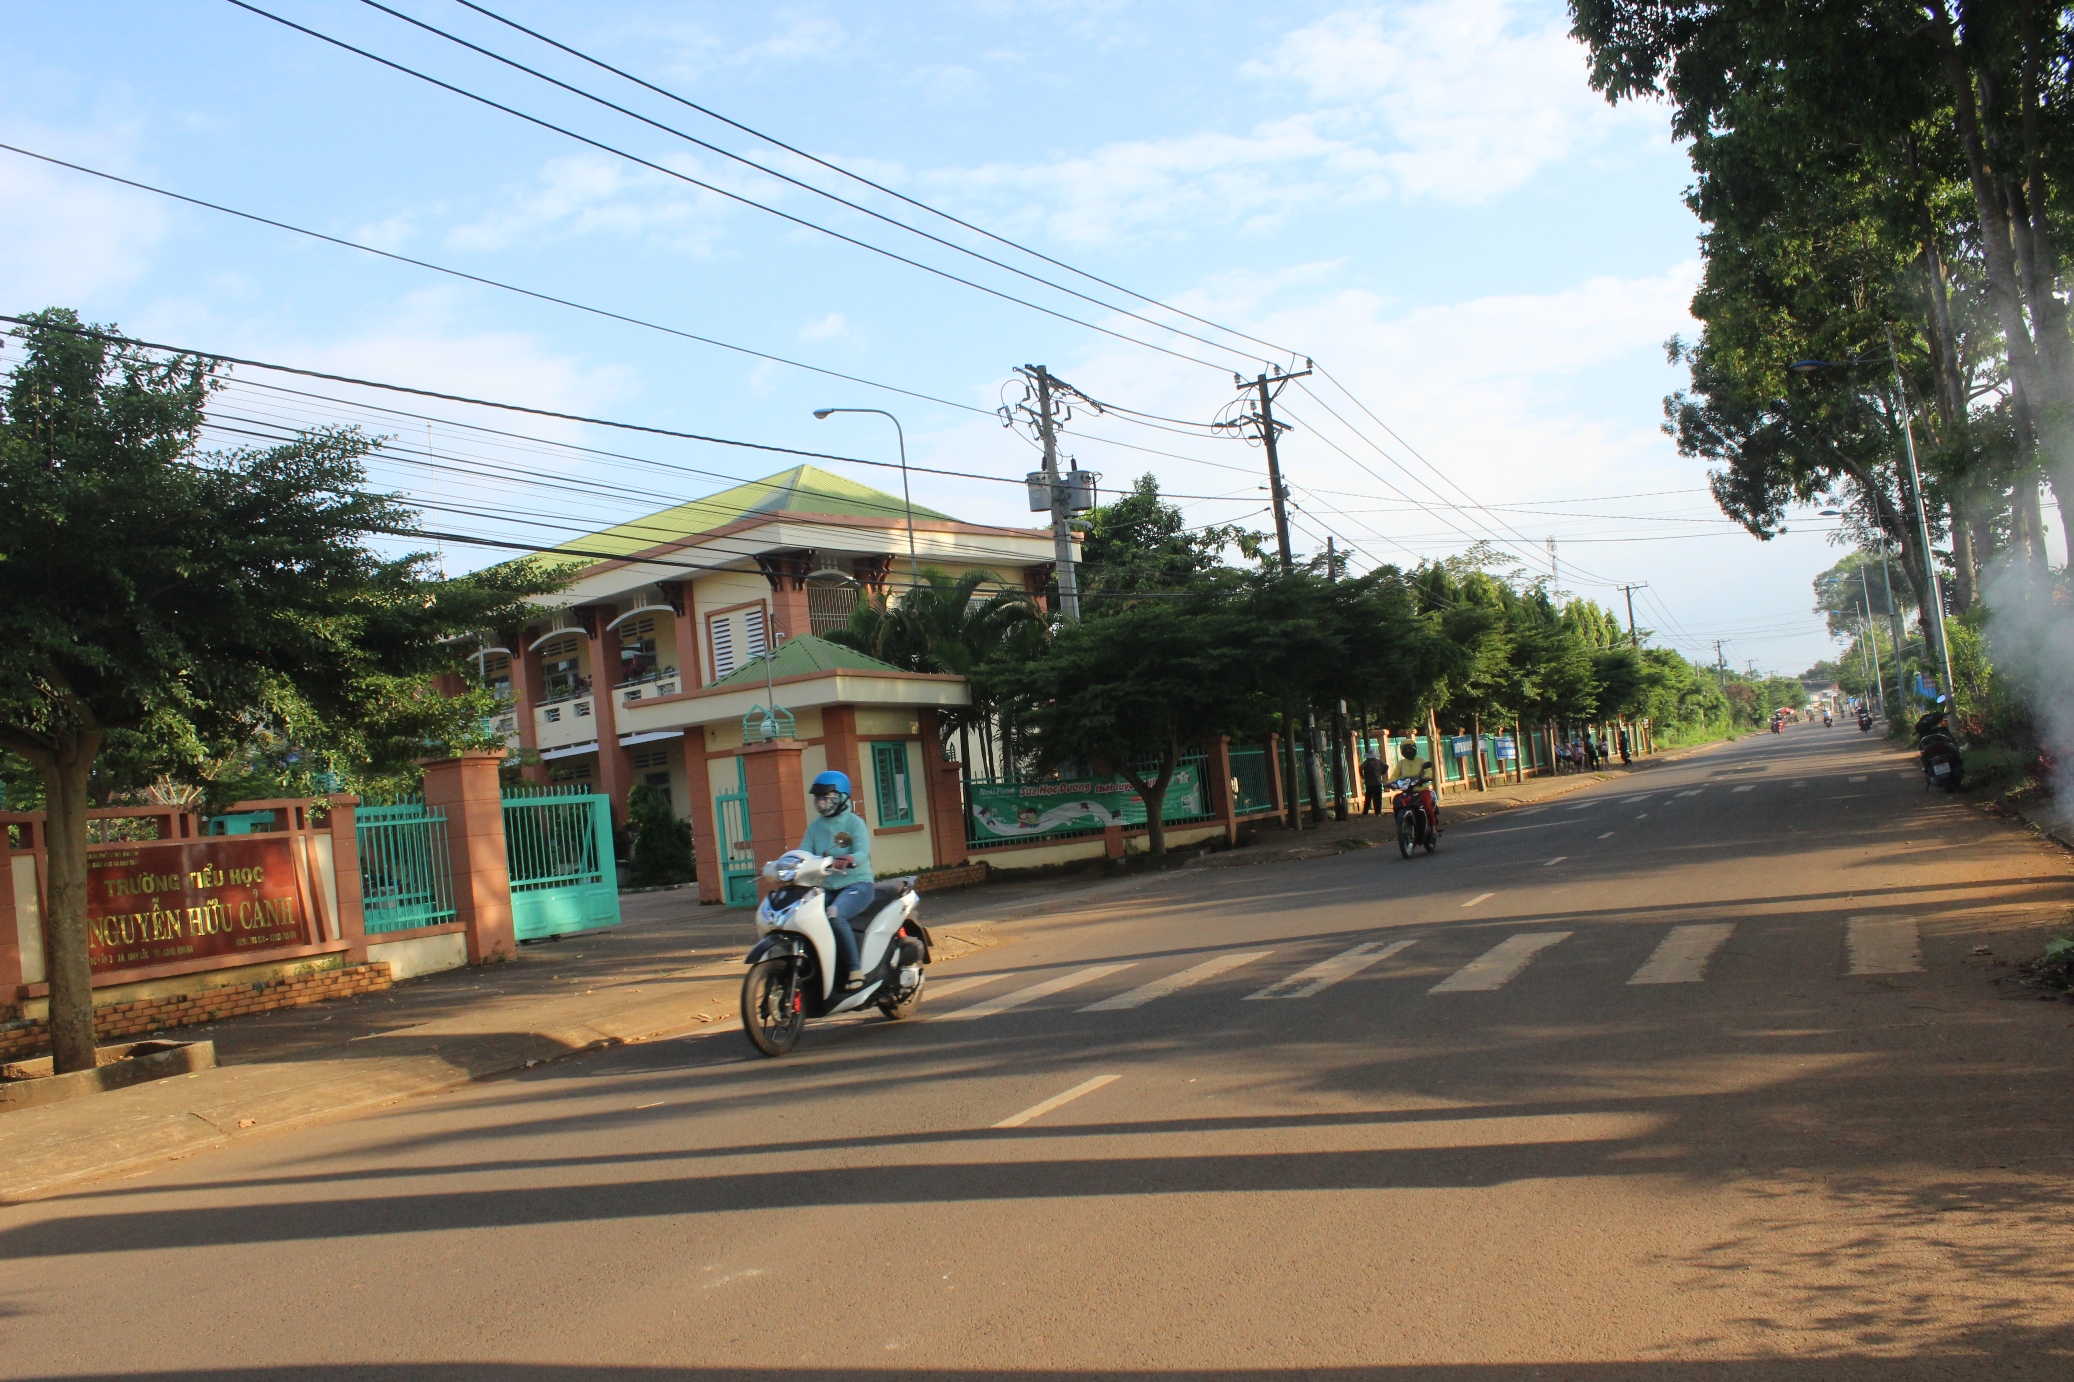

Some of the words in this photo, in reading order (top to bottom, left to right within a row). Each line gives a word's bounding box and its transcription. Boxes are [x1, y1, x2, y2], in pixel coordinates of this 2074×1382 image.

[104, 872, 180, 897] TRƯỜNG
[188, 863, 224, 889] TIỂU
[229, 866, 264, 887] HỌC
[86, 897, 182, 948] NGUYỄN
[187, 898, 233, 937] HỮU
[239, 888, 295, 930] CẢNH
